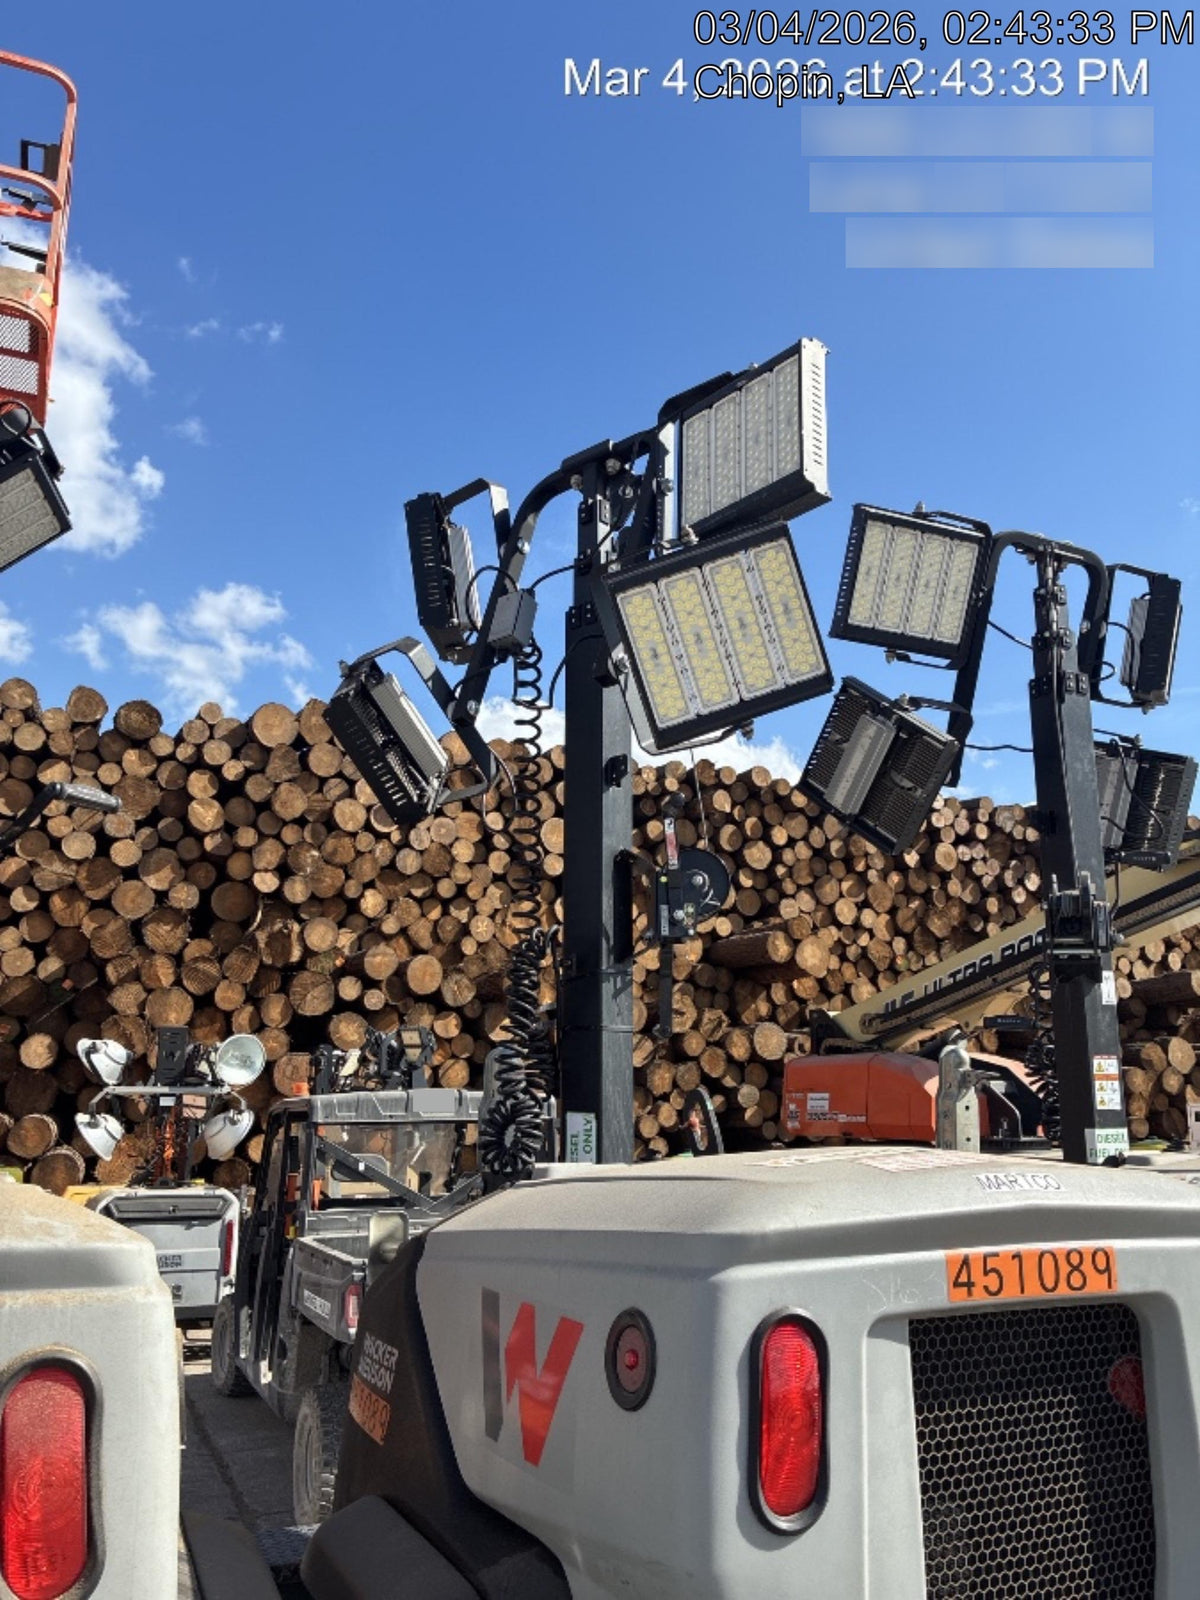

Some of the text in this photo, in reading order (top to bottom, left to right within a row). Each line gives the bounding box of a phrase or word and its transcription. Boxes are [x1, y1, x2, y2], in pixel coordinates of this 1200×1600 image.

[583, 1117, 593, 1155] ONLY
[975, 1174, 1061, 1191] MARTCO
[951, 1247, 1113, 1298] 451089
